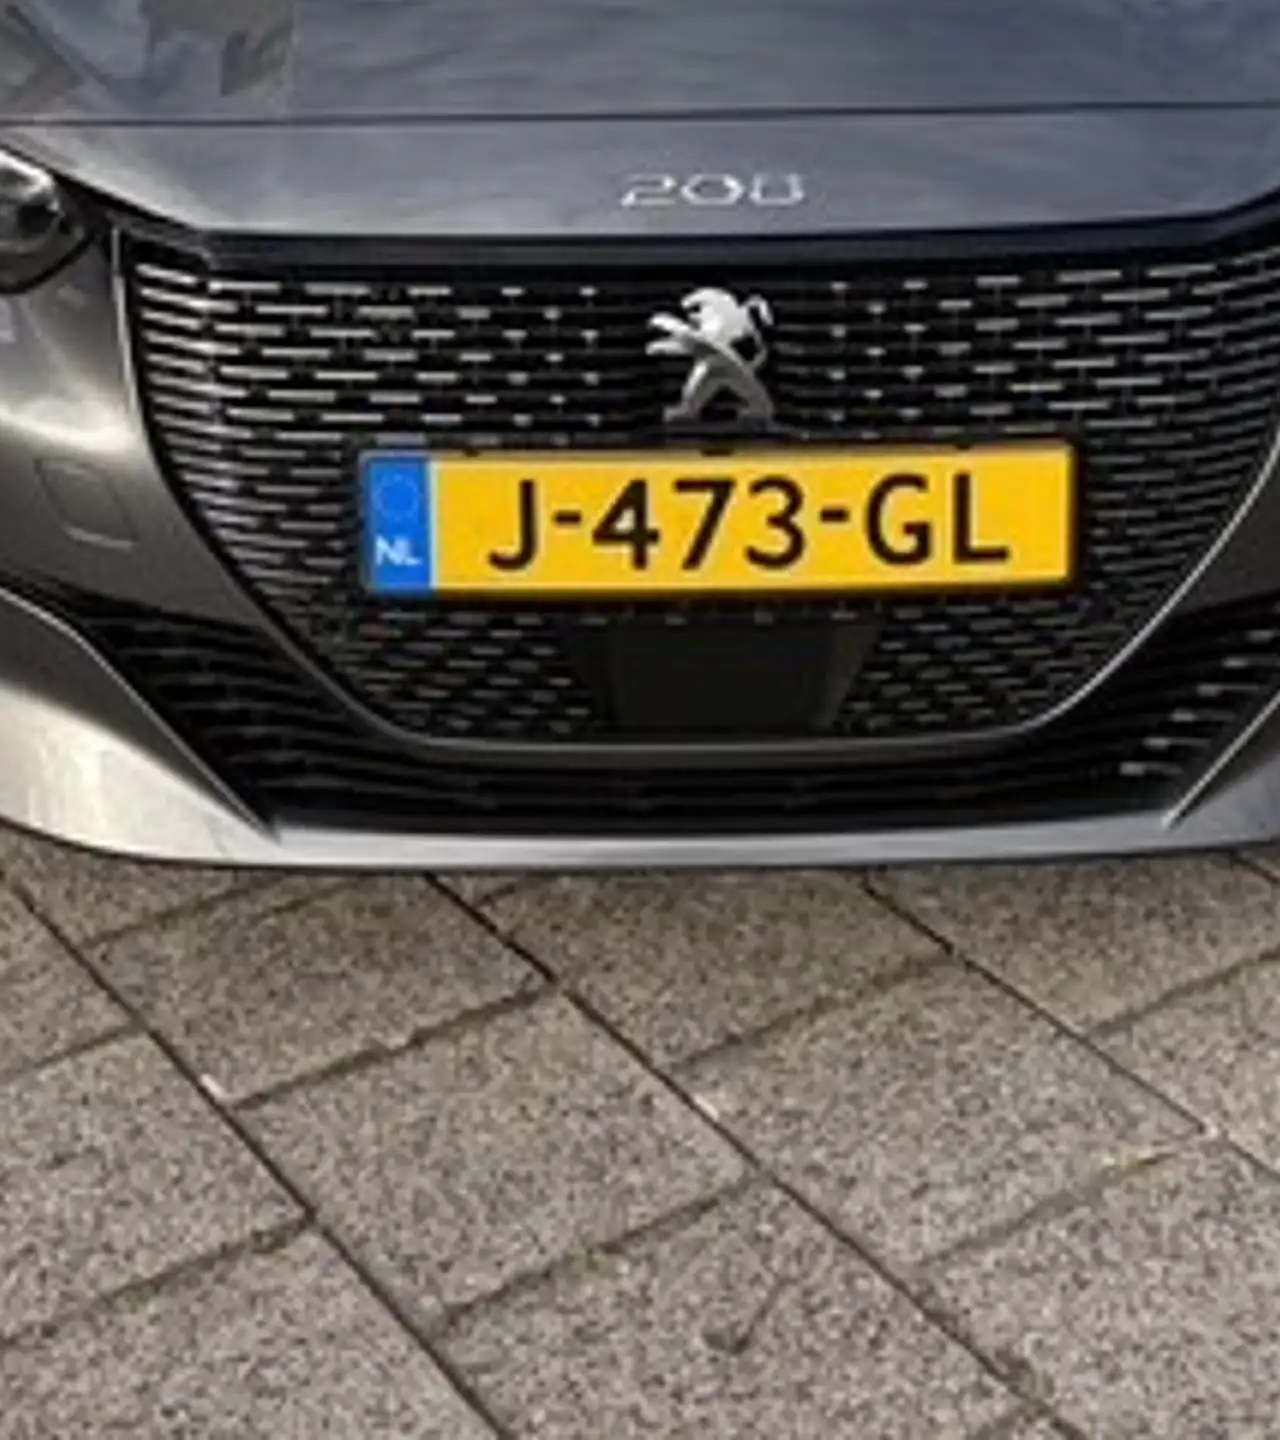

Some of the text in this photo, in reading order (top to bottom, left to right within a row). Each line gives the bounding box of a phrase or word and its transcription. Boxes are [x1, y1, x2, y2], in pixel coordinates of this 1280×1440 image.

[622, 173, 806, 207] 208
[374, 471, 1011, 573] NL J-473-GL
